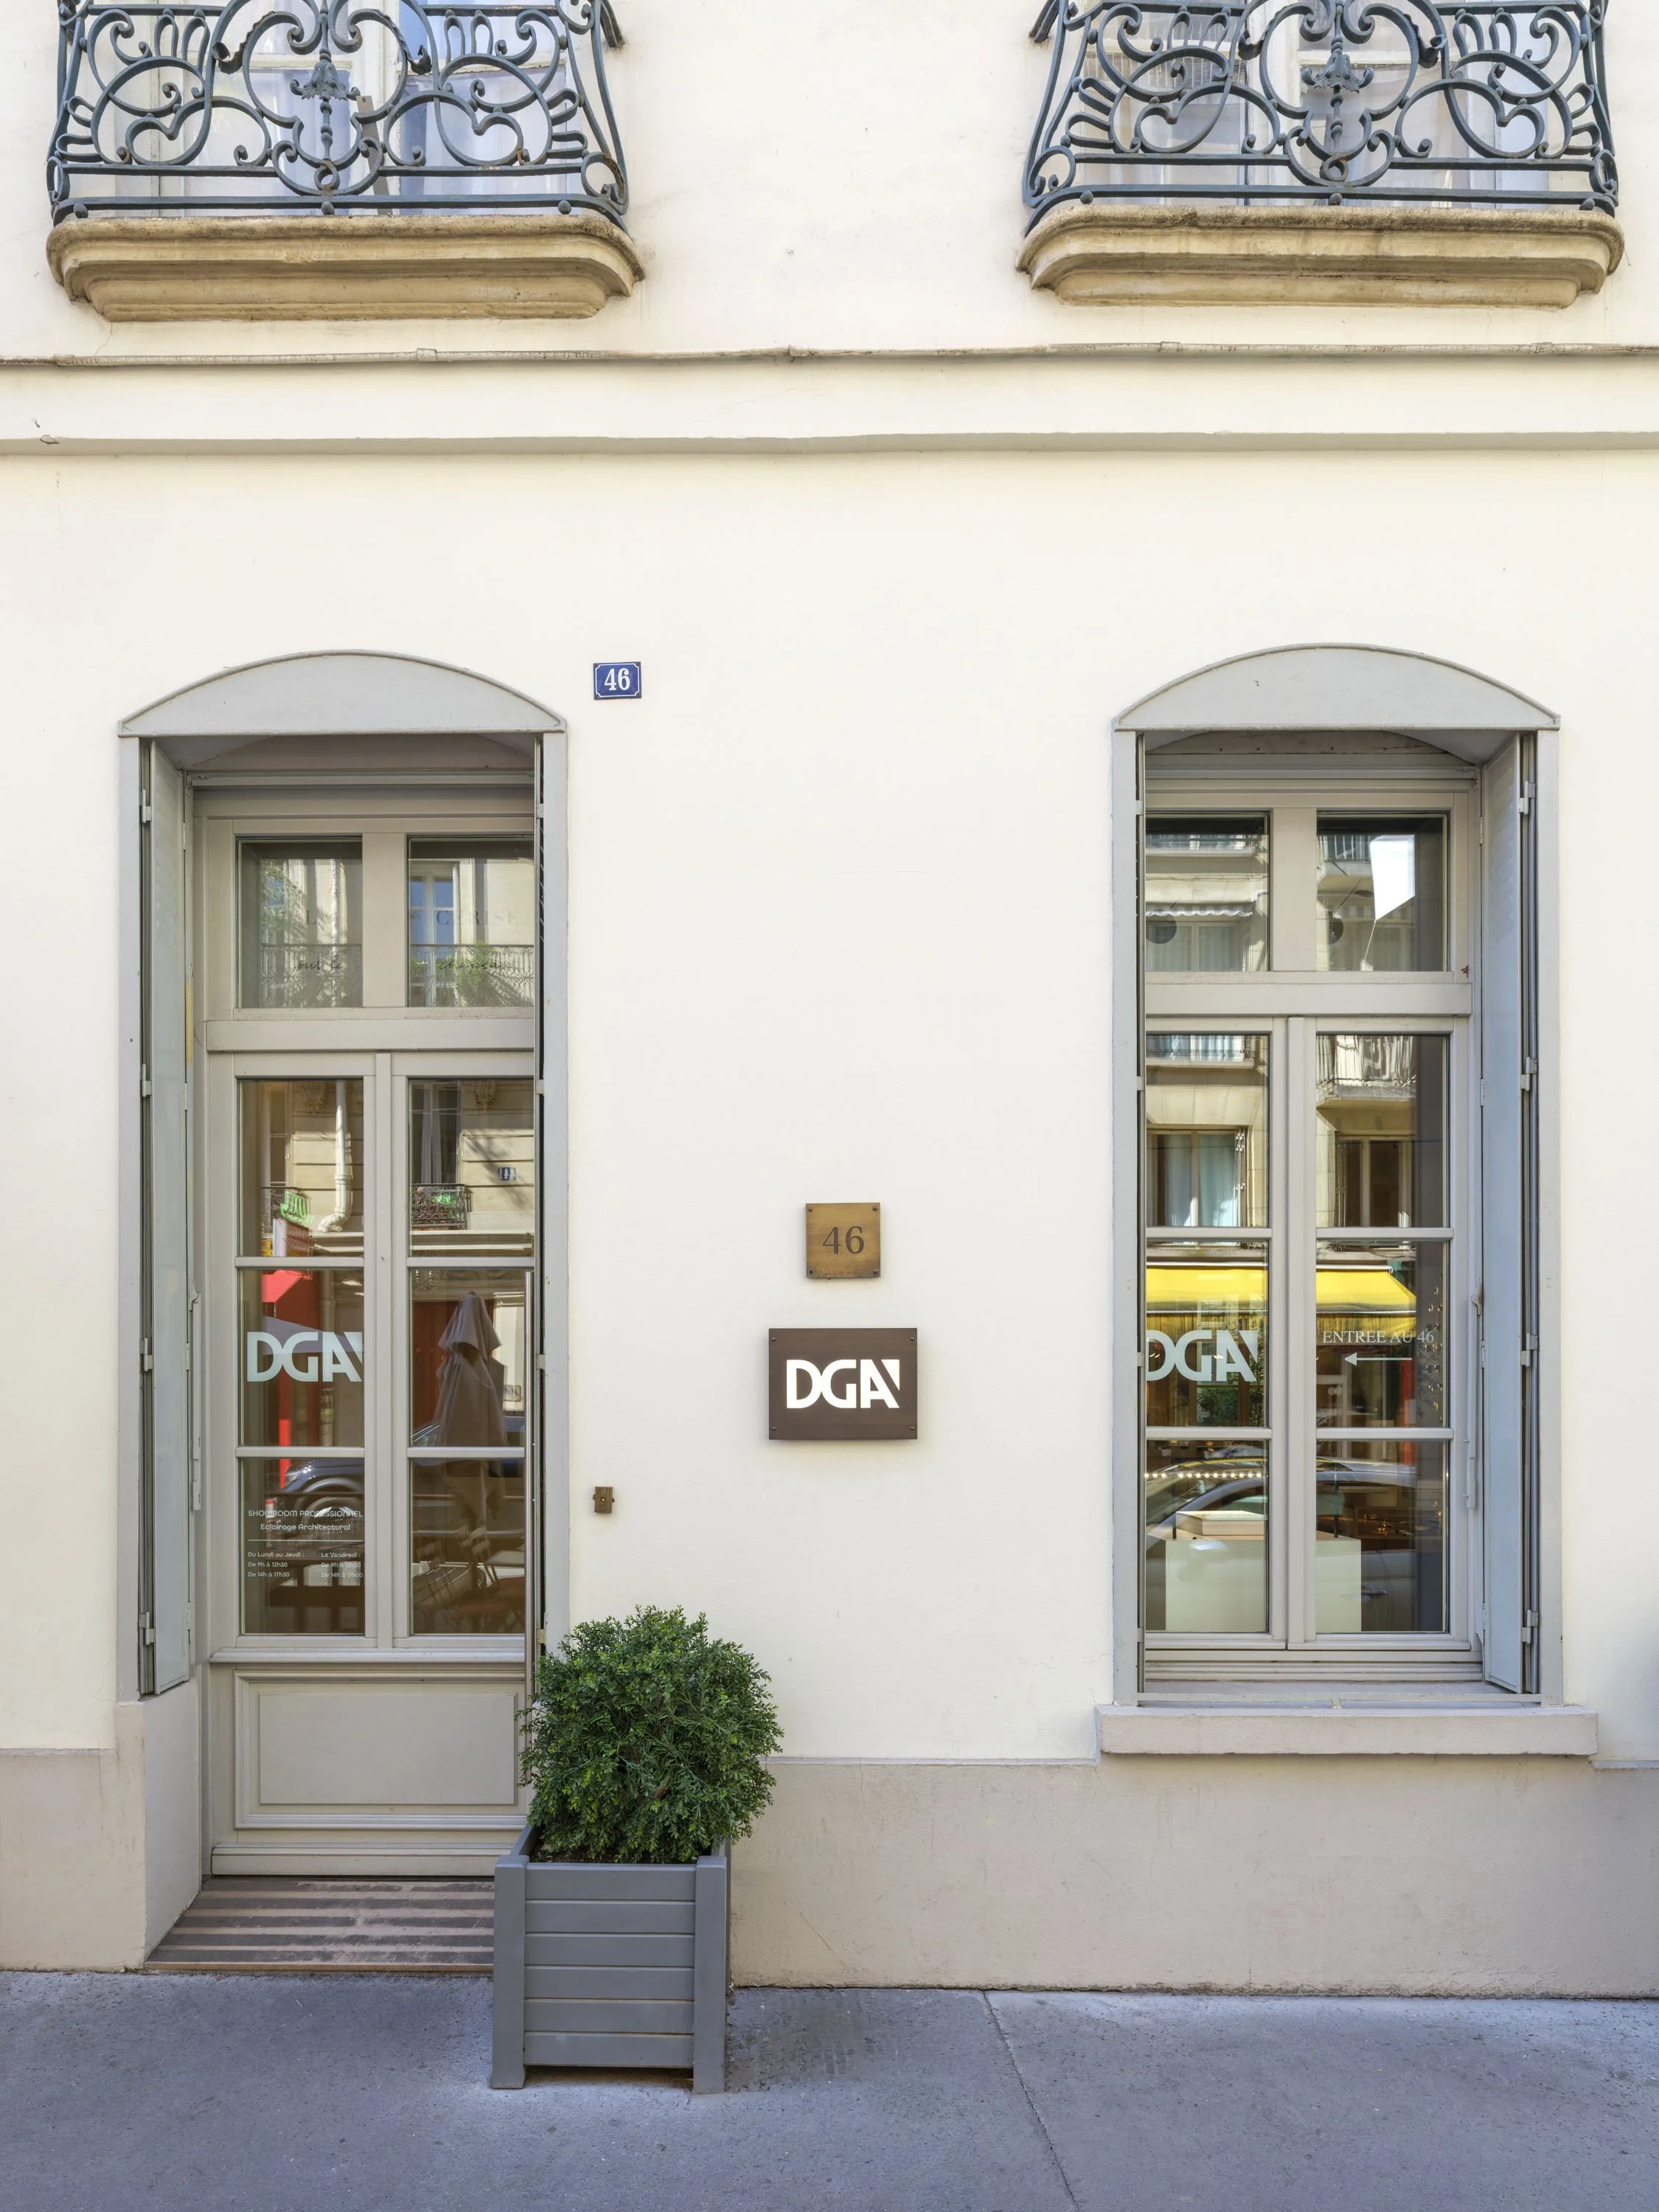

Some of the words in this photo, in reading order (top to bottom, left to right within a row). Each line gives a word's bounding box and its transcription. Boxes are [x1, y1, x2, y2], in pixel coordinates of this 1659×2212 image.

[604, 667, 630, 691] 46
[437, 910, 518, 925] CRISE
[822, 1225, 865, 1254] 46
[1322, 1330, 1386, 1343] ENTREE
[1389, 1330, 1413, 1343] AU
[1417, 1330, 1435, 1343] 46
[247, 1332, 363, 1382] DGA
[1146, 1329, 1259, 1382] DGA
[786, 1359, 900, 1409] DGA
[260, 1523, 296, 1532] Eclairage
